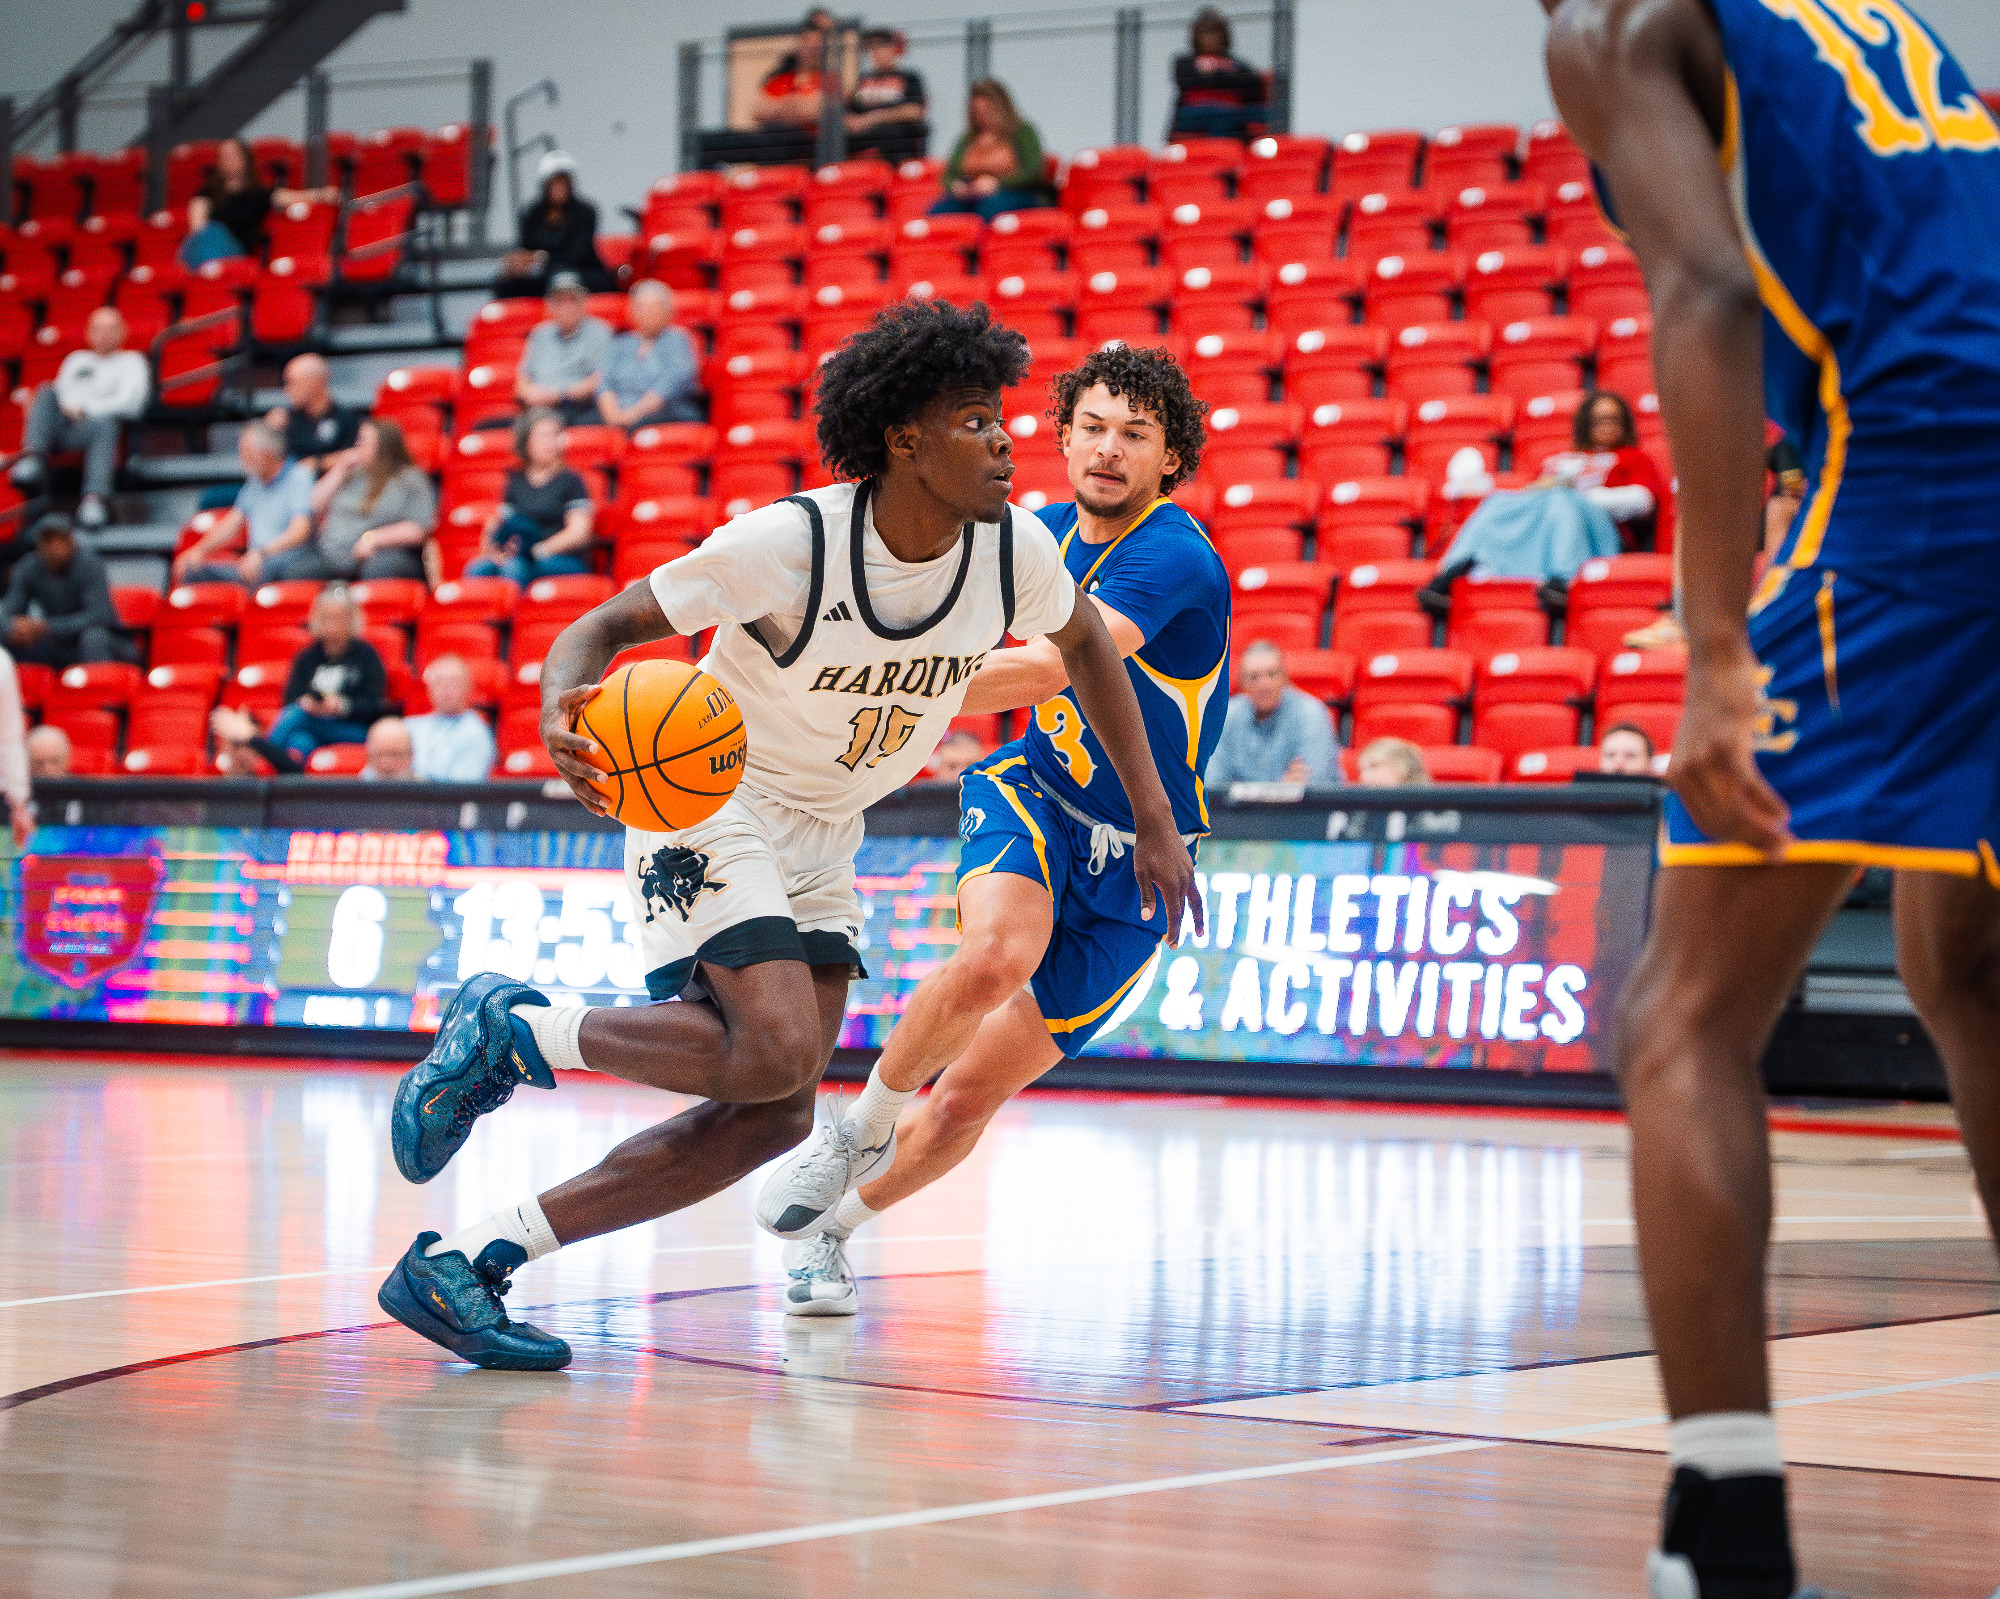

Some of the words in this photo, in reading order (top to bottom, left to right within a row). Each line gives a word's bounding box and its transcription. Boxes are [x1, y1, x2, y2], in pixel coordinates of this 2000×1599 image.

[1760, 0, 2000, 157] 12
[1035, 694, 1098, 789] 3
[327, 885, 387, 989] 6
[1159, 955, 1204, 1031] &
[1220, 956, 1588, 1044] ACTIVITIES
